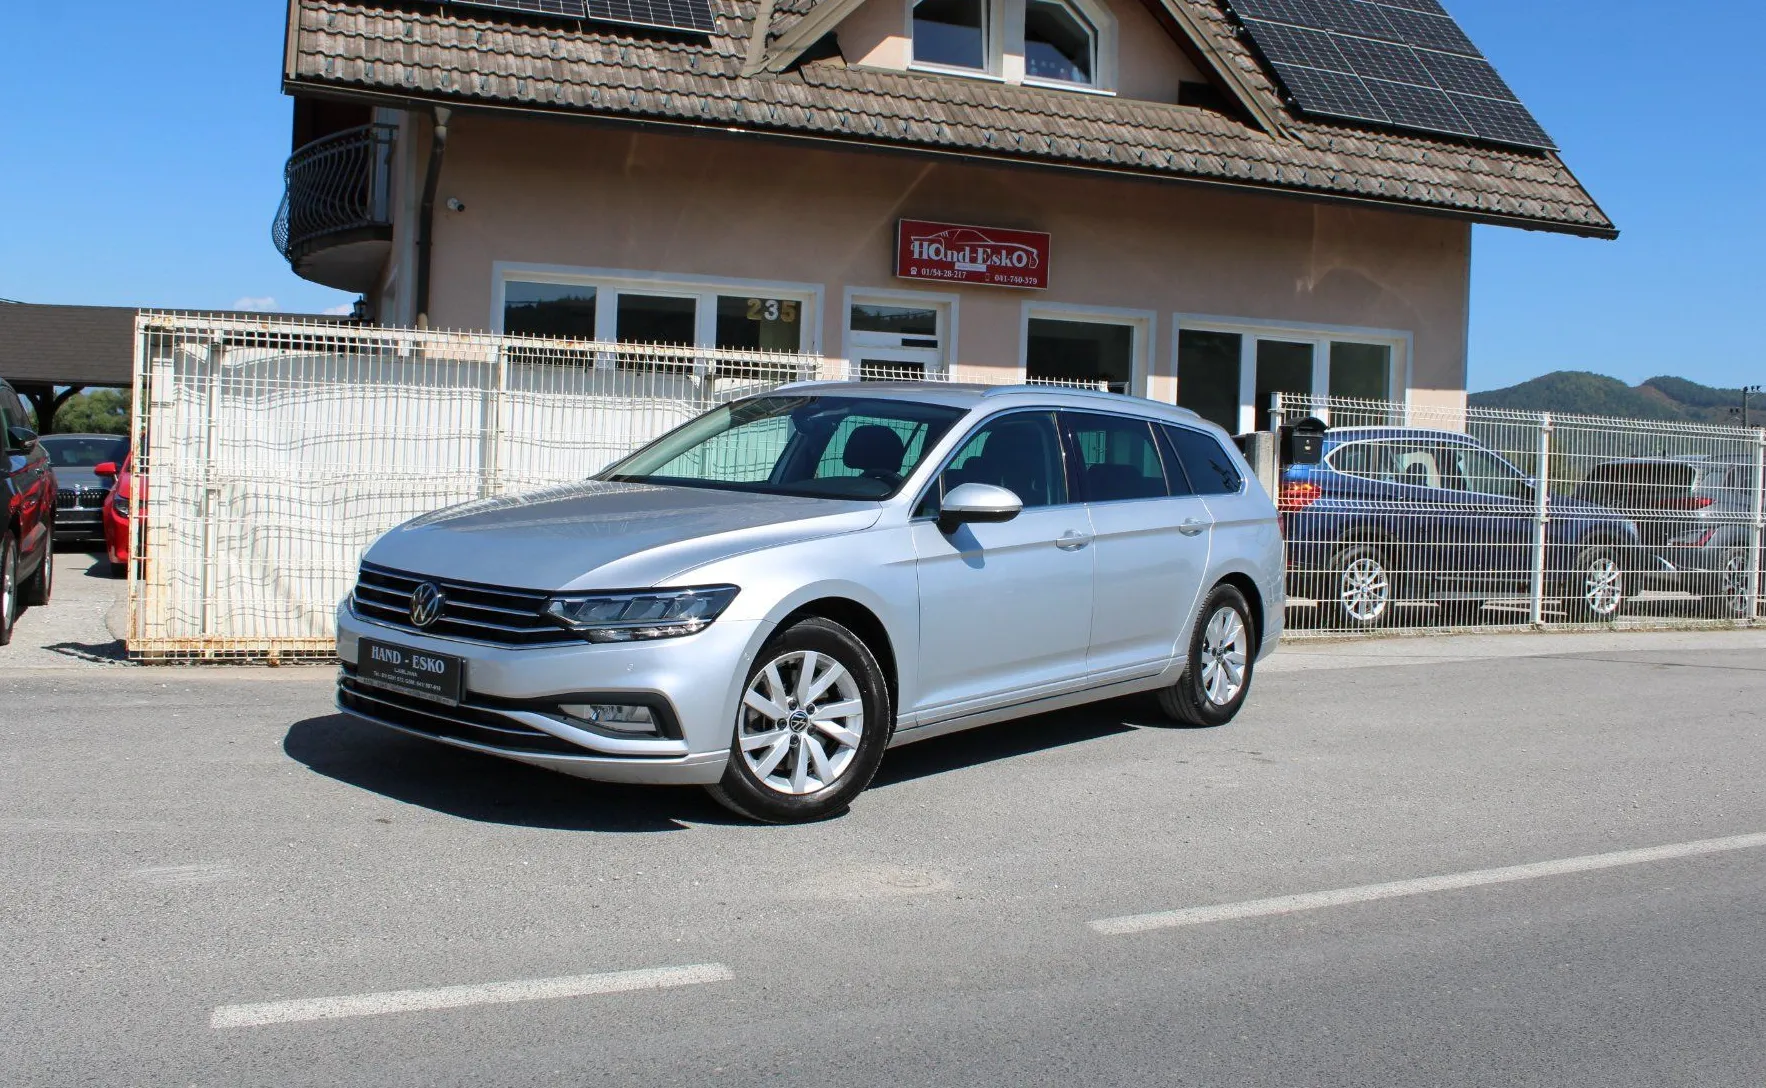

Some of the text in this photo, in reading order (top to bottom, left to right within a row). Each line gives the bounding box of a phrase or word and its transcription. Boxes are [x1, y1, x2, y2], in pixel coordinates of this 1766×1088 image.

[747, 299, 796, 322] 235
[371, 645, 401, 664] HAND
[412, 655, 445, 674] ESKO
